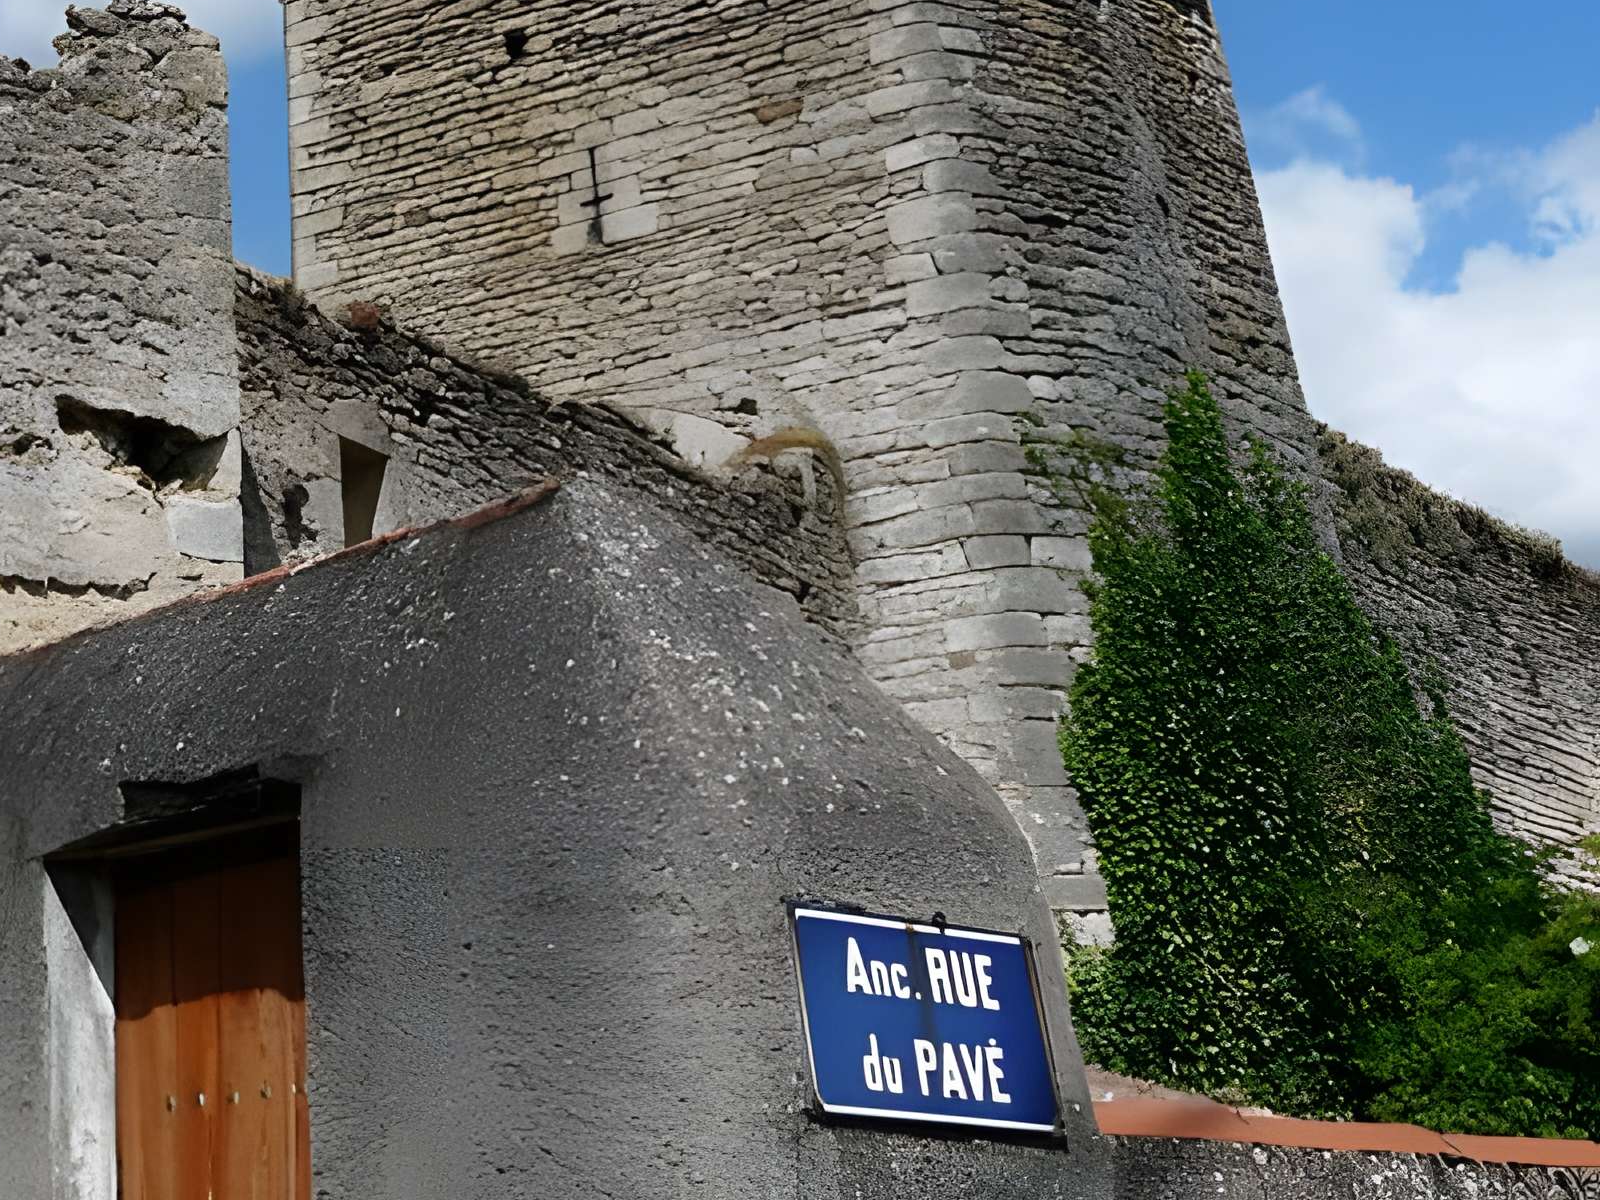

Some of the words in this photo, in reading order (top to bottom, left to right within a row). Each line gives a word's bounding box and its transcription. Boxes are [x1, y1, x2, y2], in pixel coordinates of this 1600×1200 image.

[846, 936, 922, 1000] Anc.
[924, 947, 1001, 1011] RUE
[863, 1033, 904, 1094] du
